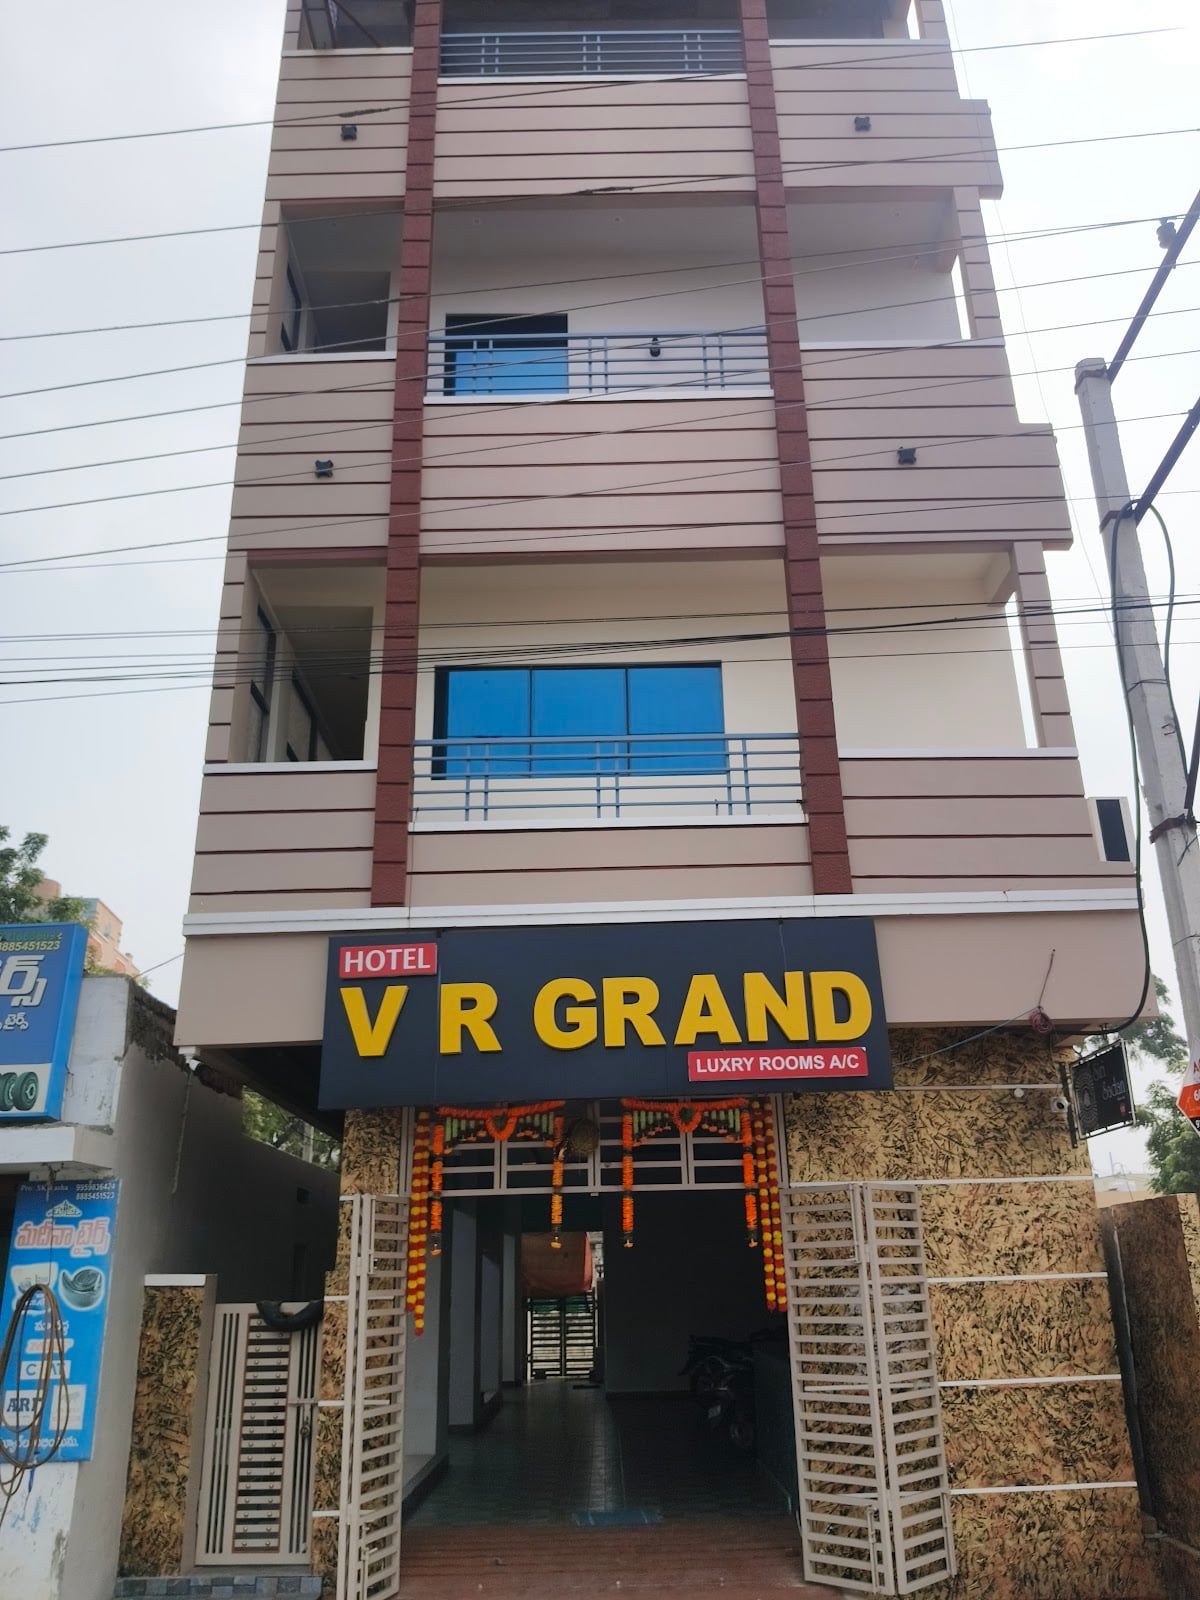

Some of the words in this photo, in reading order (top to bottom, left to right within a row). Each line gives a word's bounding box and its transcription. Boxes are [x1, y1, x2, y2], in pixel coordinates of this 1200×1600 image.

[344, 948, 431, 973] HOTEL
[340, 985, 409, 1057] V
[440, 982, 502, 1054] R
[533, 971, 872, 1050] GRAND
[696, 1057, 753, 1073] LUXRY
[759, 1054, 826, 1071] ROOMS
[829, 1053, 860, 1070] A/C
[25, 1363, 65, 1375] CAT
